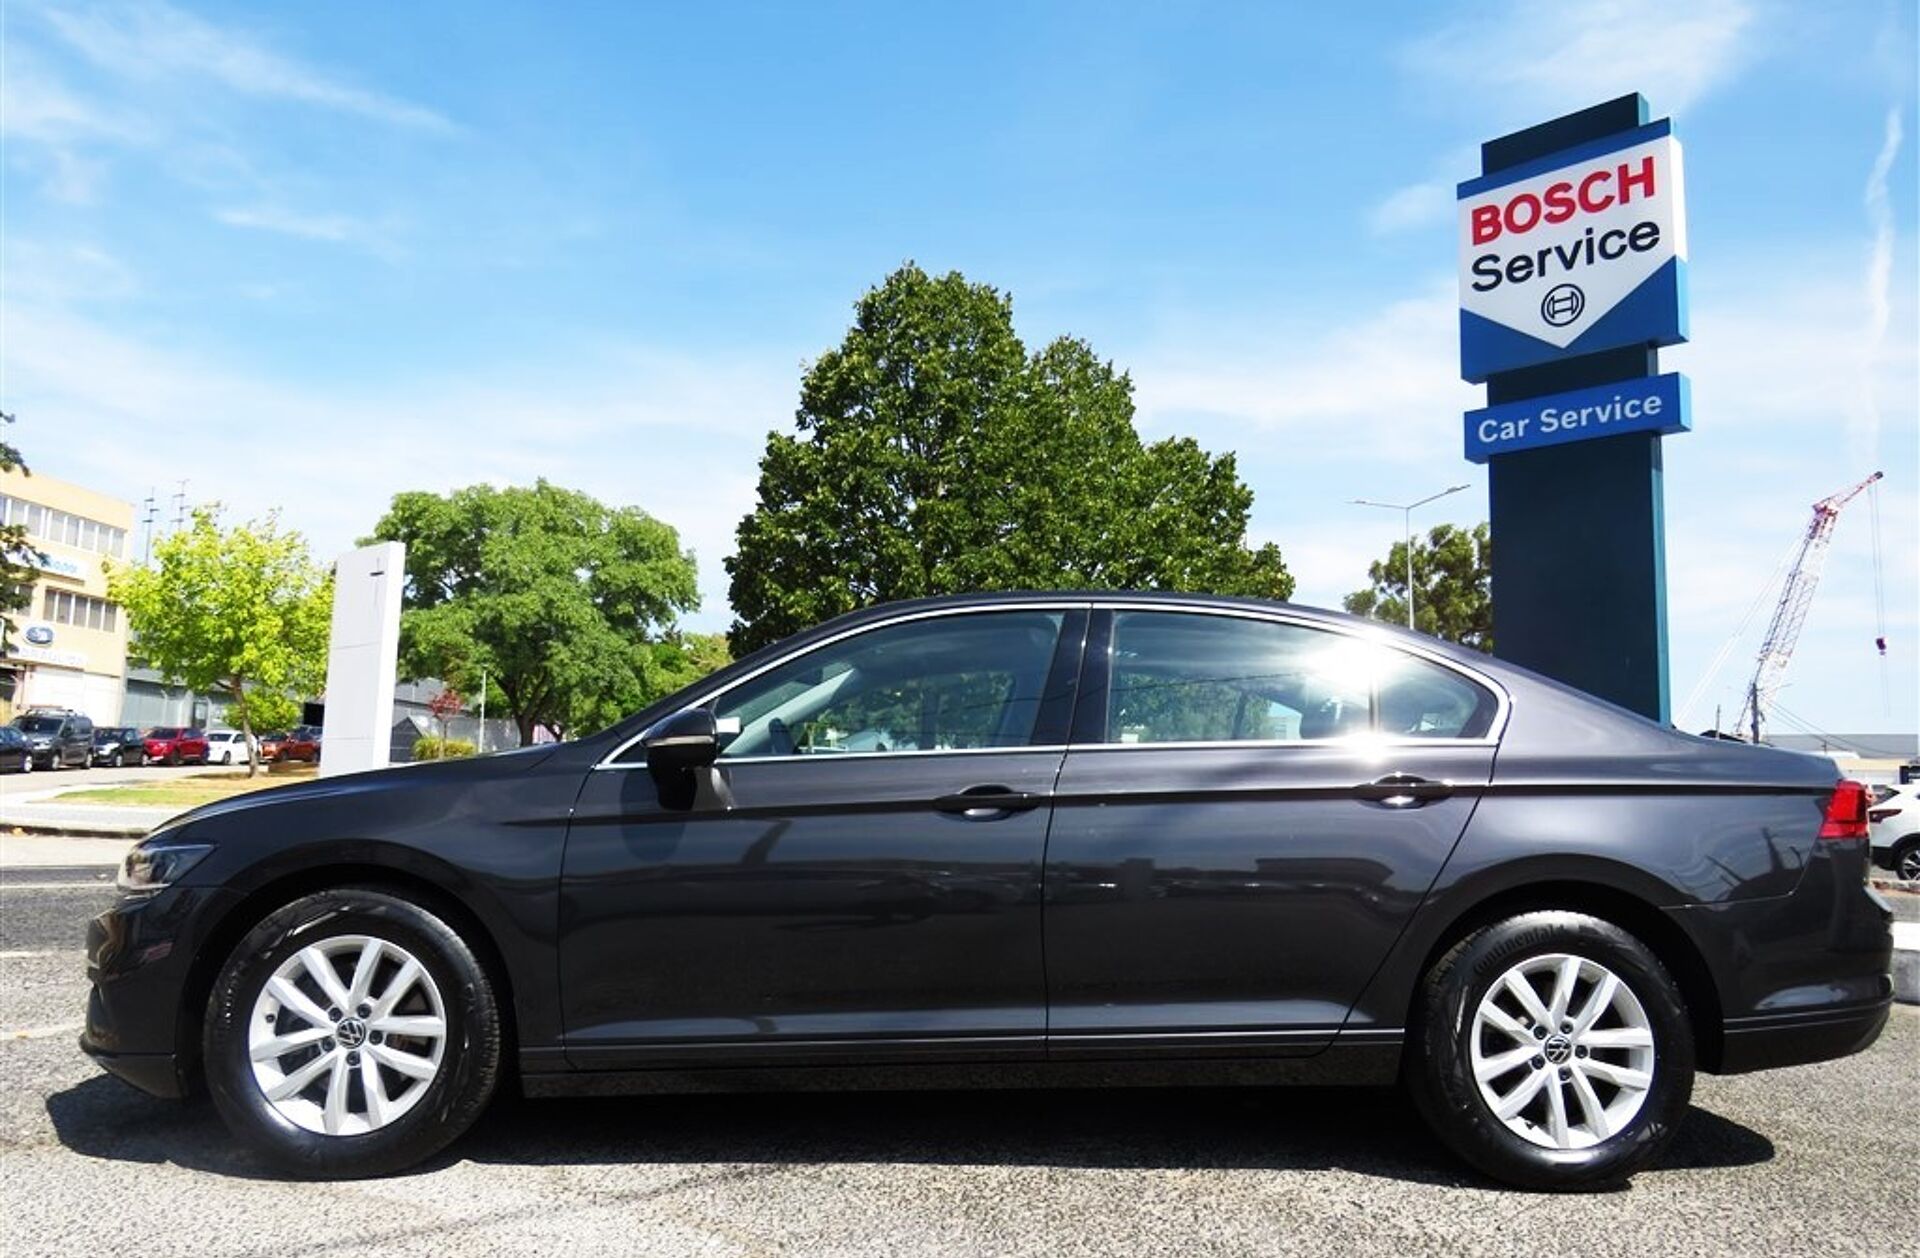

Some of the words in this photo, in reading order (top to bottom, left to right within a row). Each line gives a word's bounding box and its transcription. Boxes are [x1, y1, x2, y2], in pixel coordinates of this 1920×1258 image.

[1471, 156, 1655, 245] BOSCH
[1472, 221, 1660, 292] Service
[1478, 418, 1530, 443] Car
[1540, 394, 1662, 432] Service
